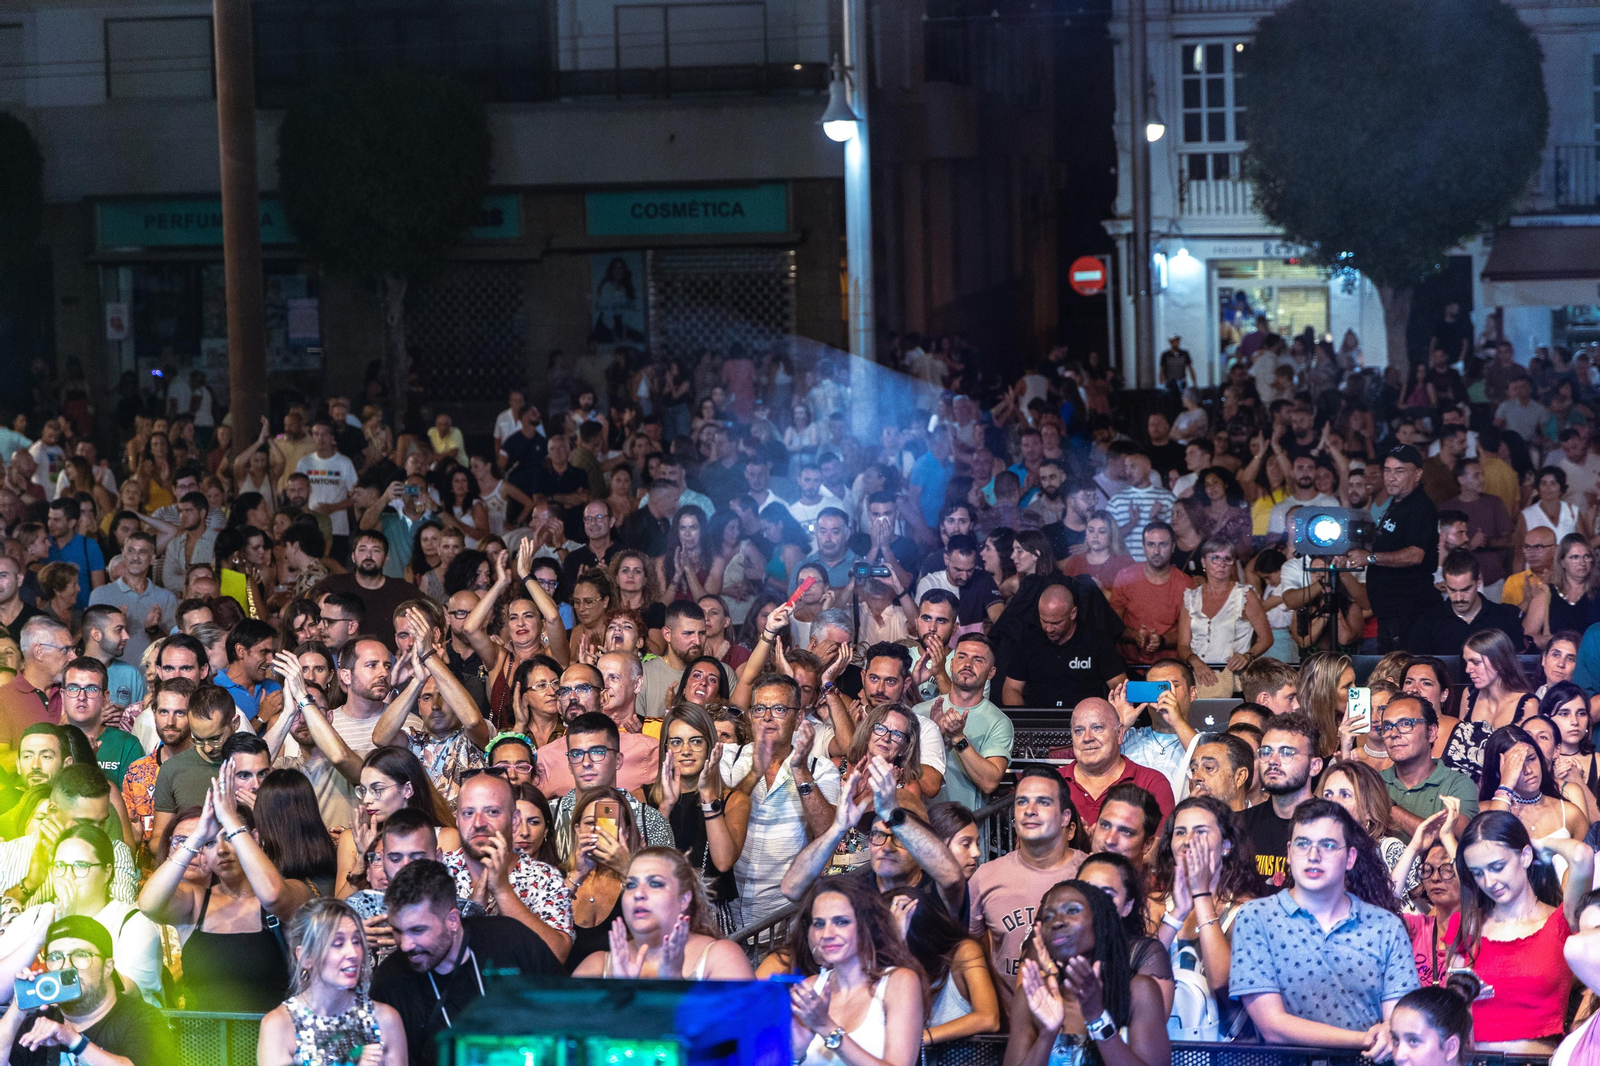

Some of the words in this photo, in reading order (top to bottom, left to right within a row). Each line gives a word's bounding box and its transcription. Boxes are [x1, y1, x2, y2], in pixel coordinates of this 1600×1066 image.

[630, 200, 744, 219] COSMÉTICA
[143, 211, 273, 230] PERFUMA
[1068, 656, 1092, 669] dial
